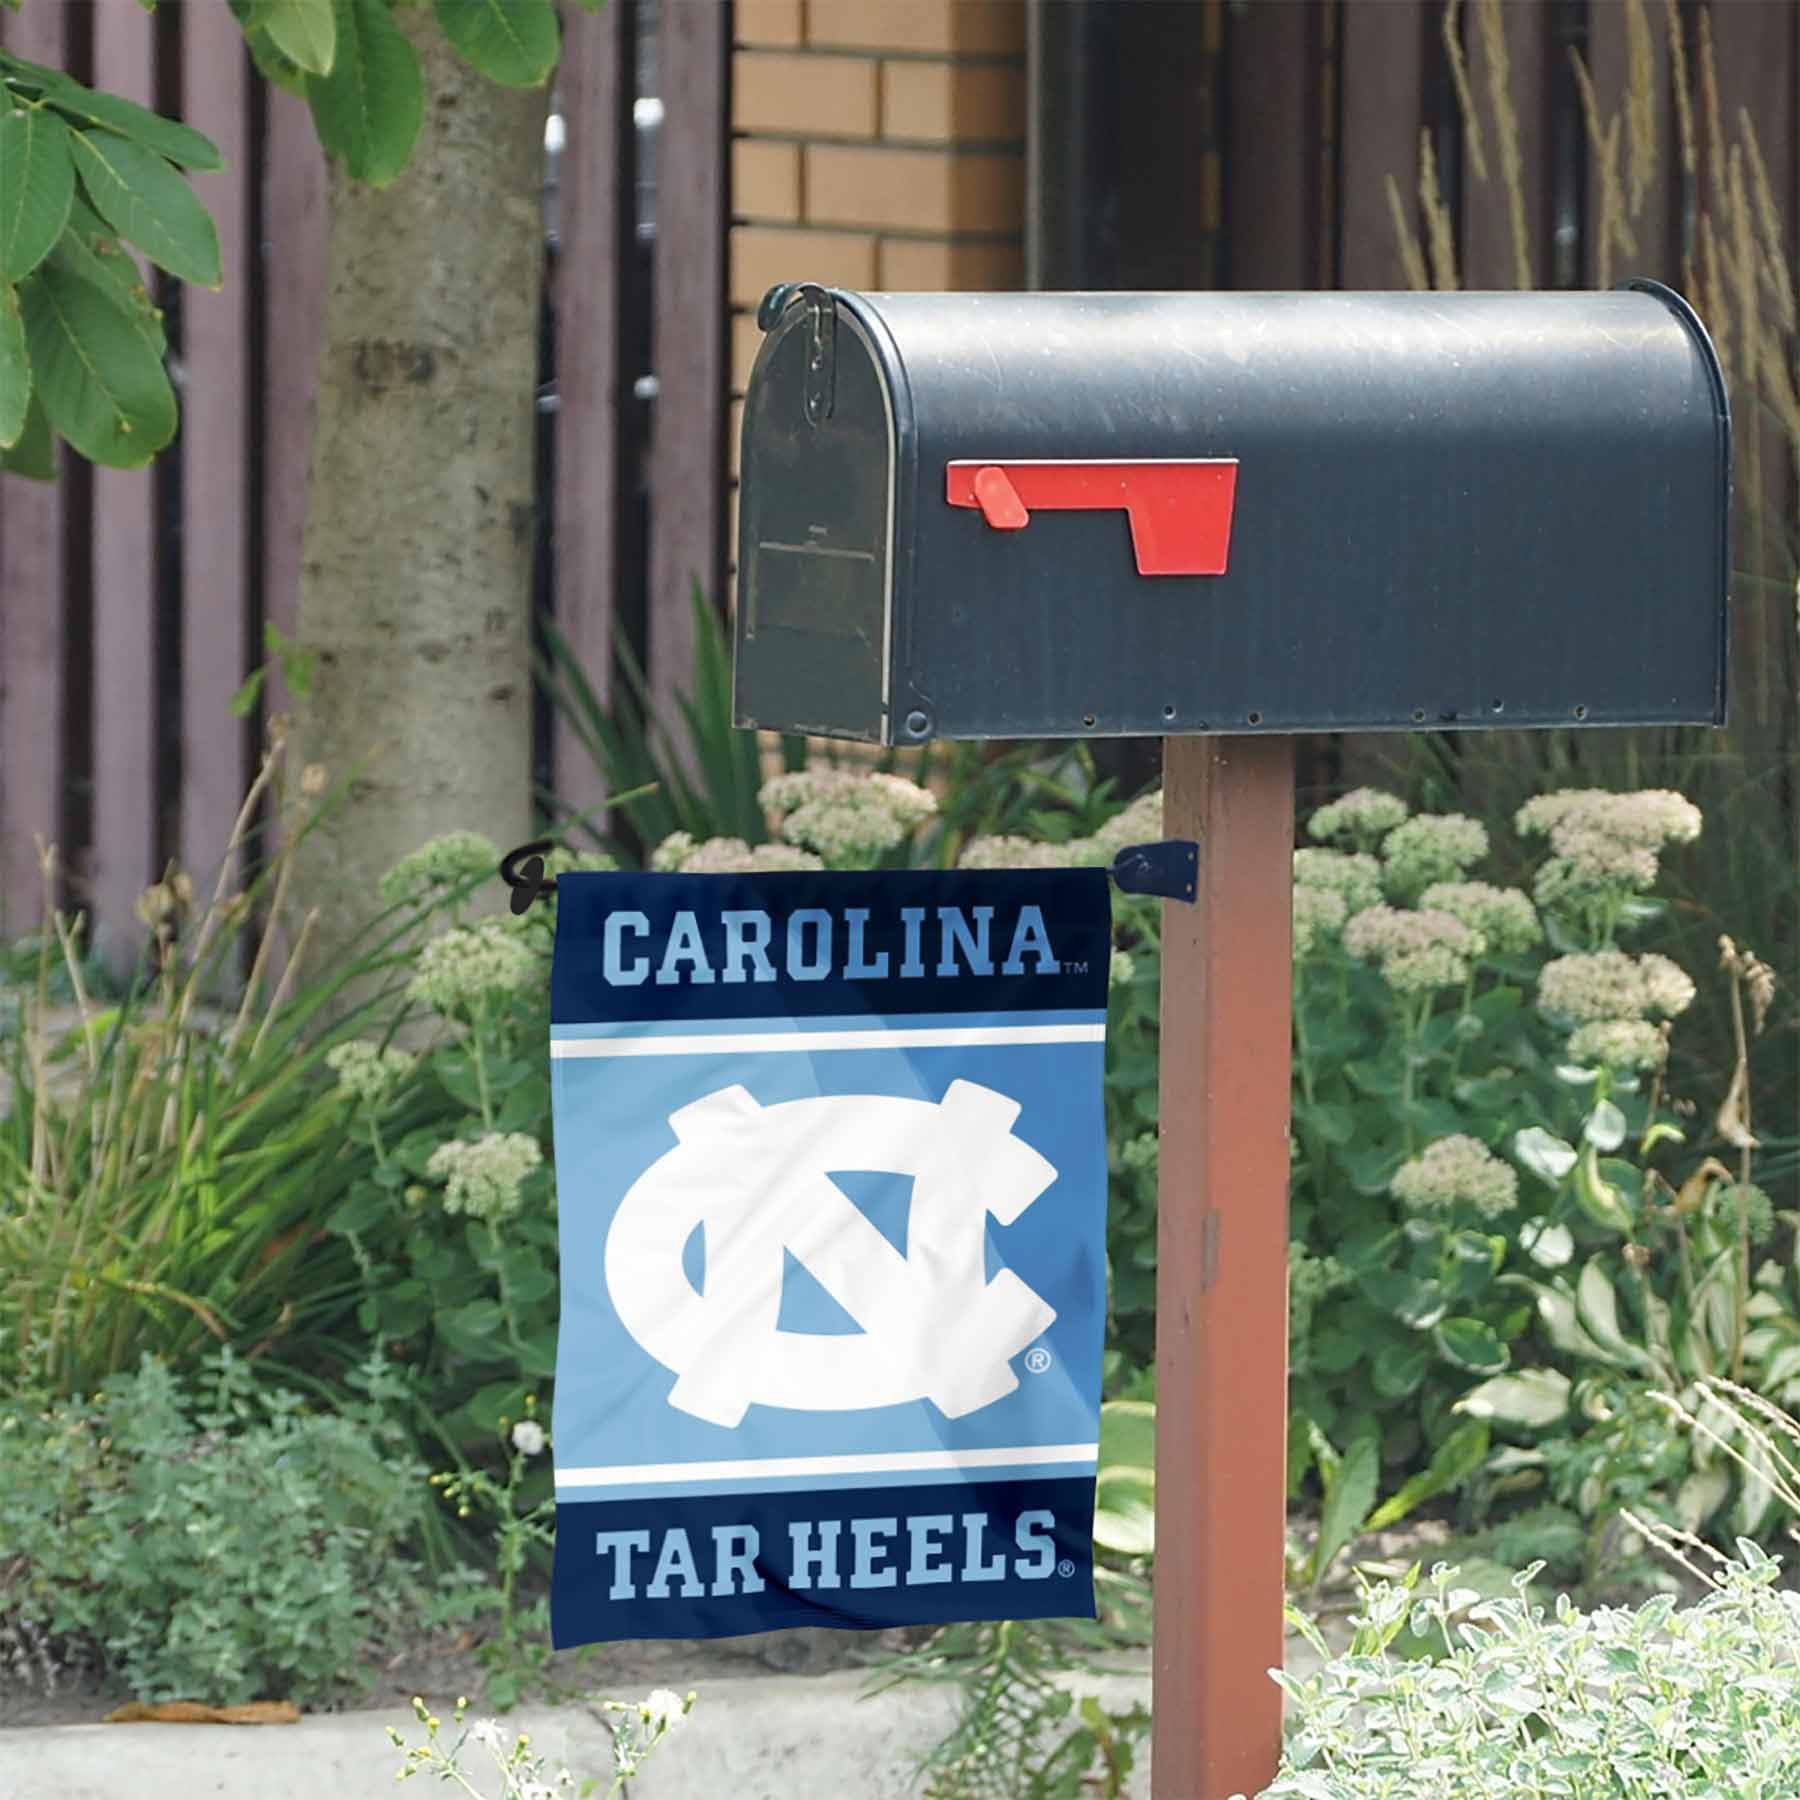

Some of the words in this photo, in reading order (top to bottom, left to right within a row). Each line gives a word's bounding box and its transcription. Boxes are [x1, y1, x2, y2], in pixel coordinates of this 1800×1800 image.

[603, 904, 1061, 986] CAROLINA
[595, 1523, 765, 1600] TAR
[788, 1510, 1057, 1590] HEELS
